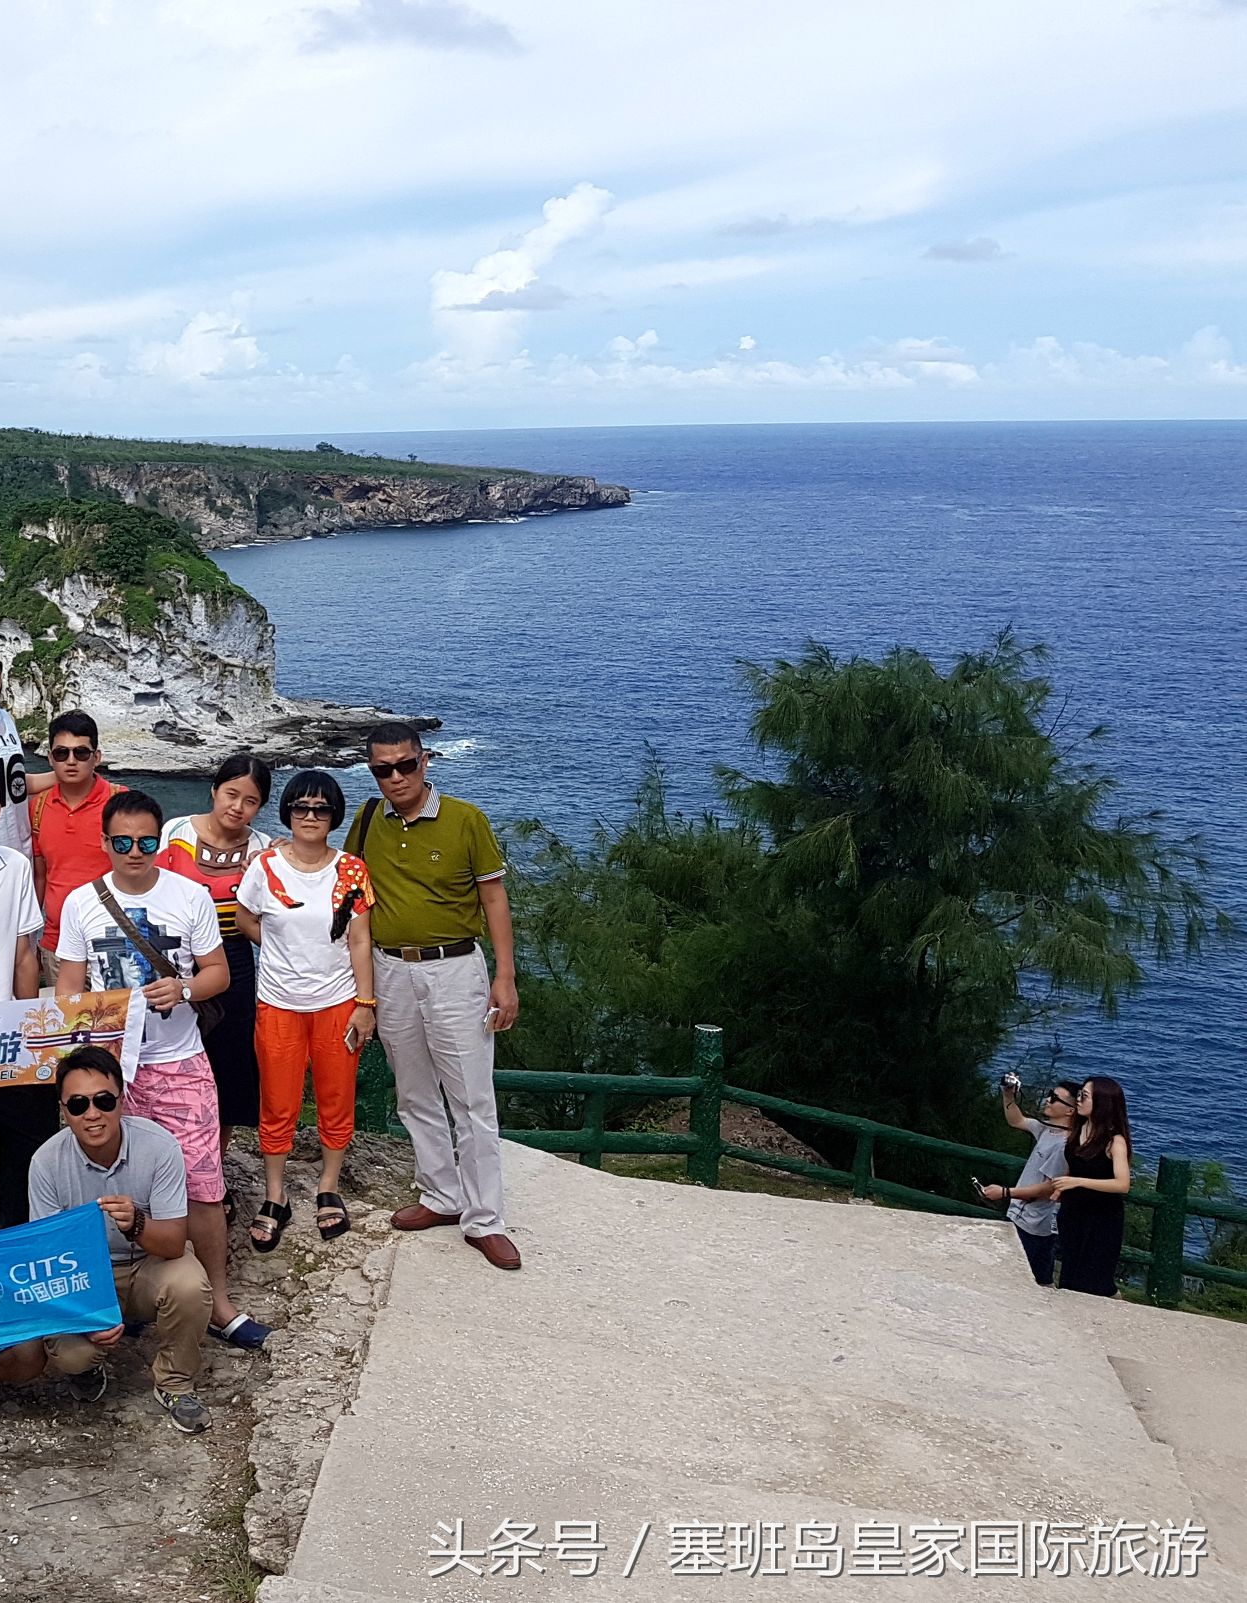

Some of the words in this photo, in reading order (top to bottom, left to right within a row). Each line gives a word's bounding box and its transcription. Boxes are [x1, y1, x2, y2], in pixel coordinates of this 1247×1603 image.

[9, 1251, 79, 1285] CITS
[13, 1271, 91, 1305] 中国国旅
